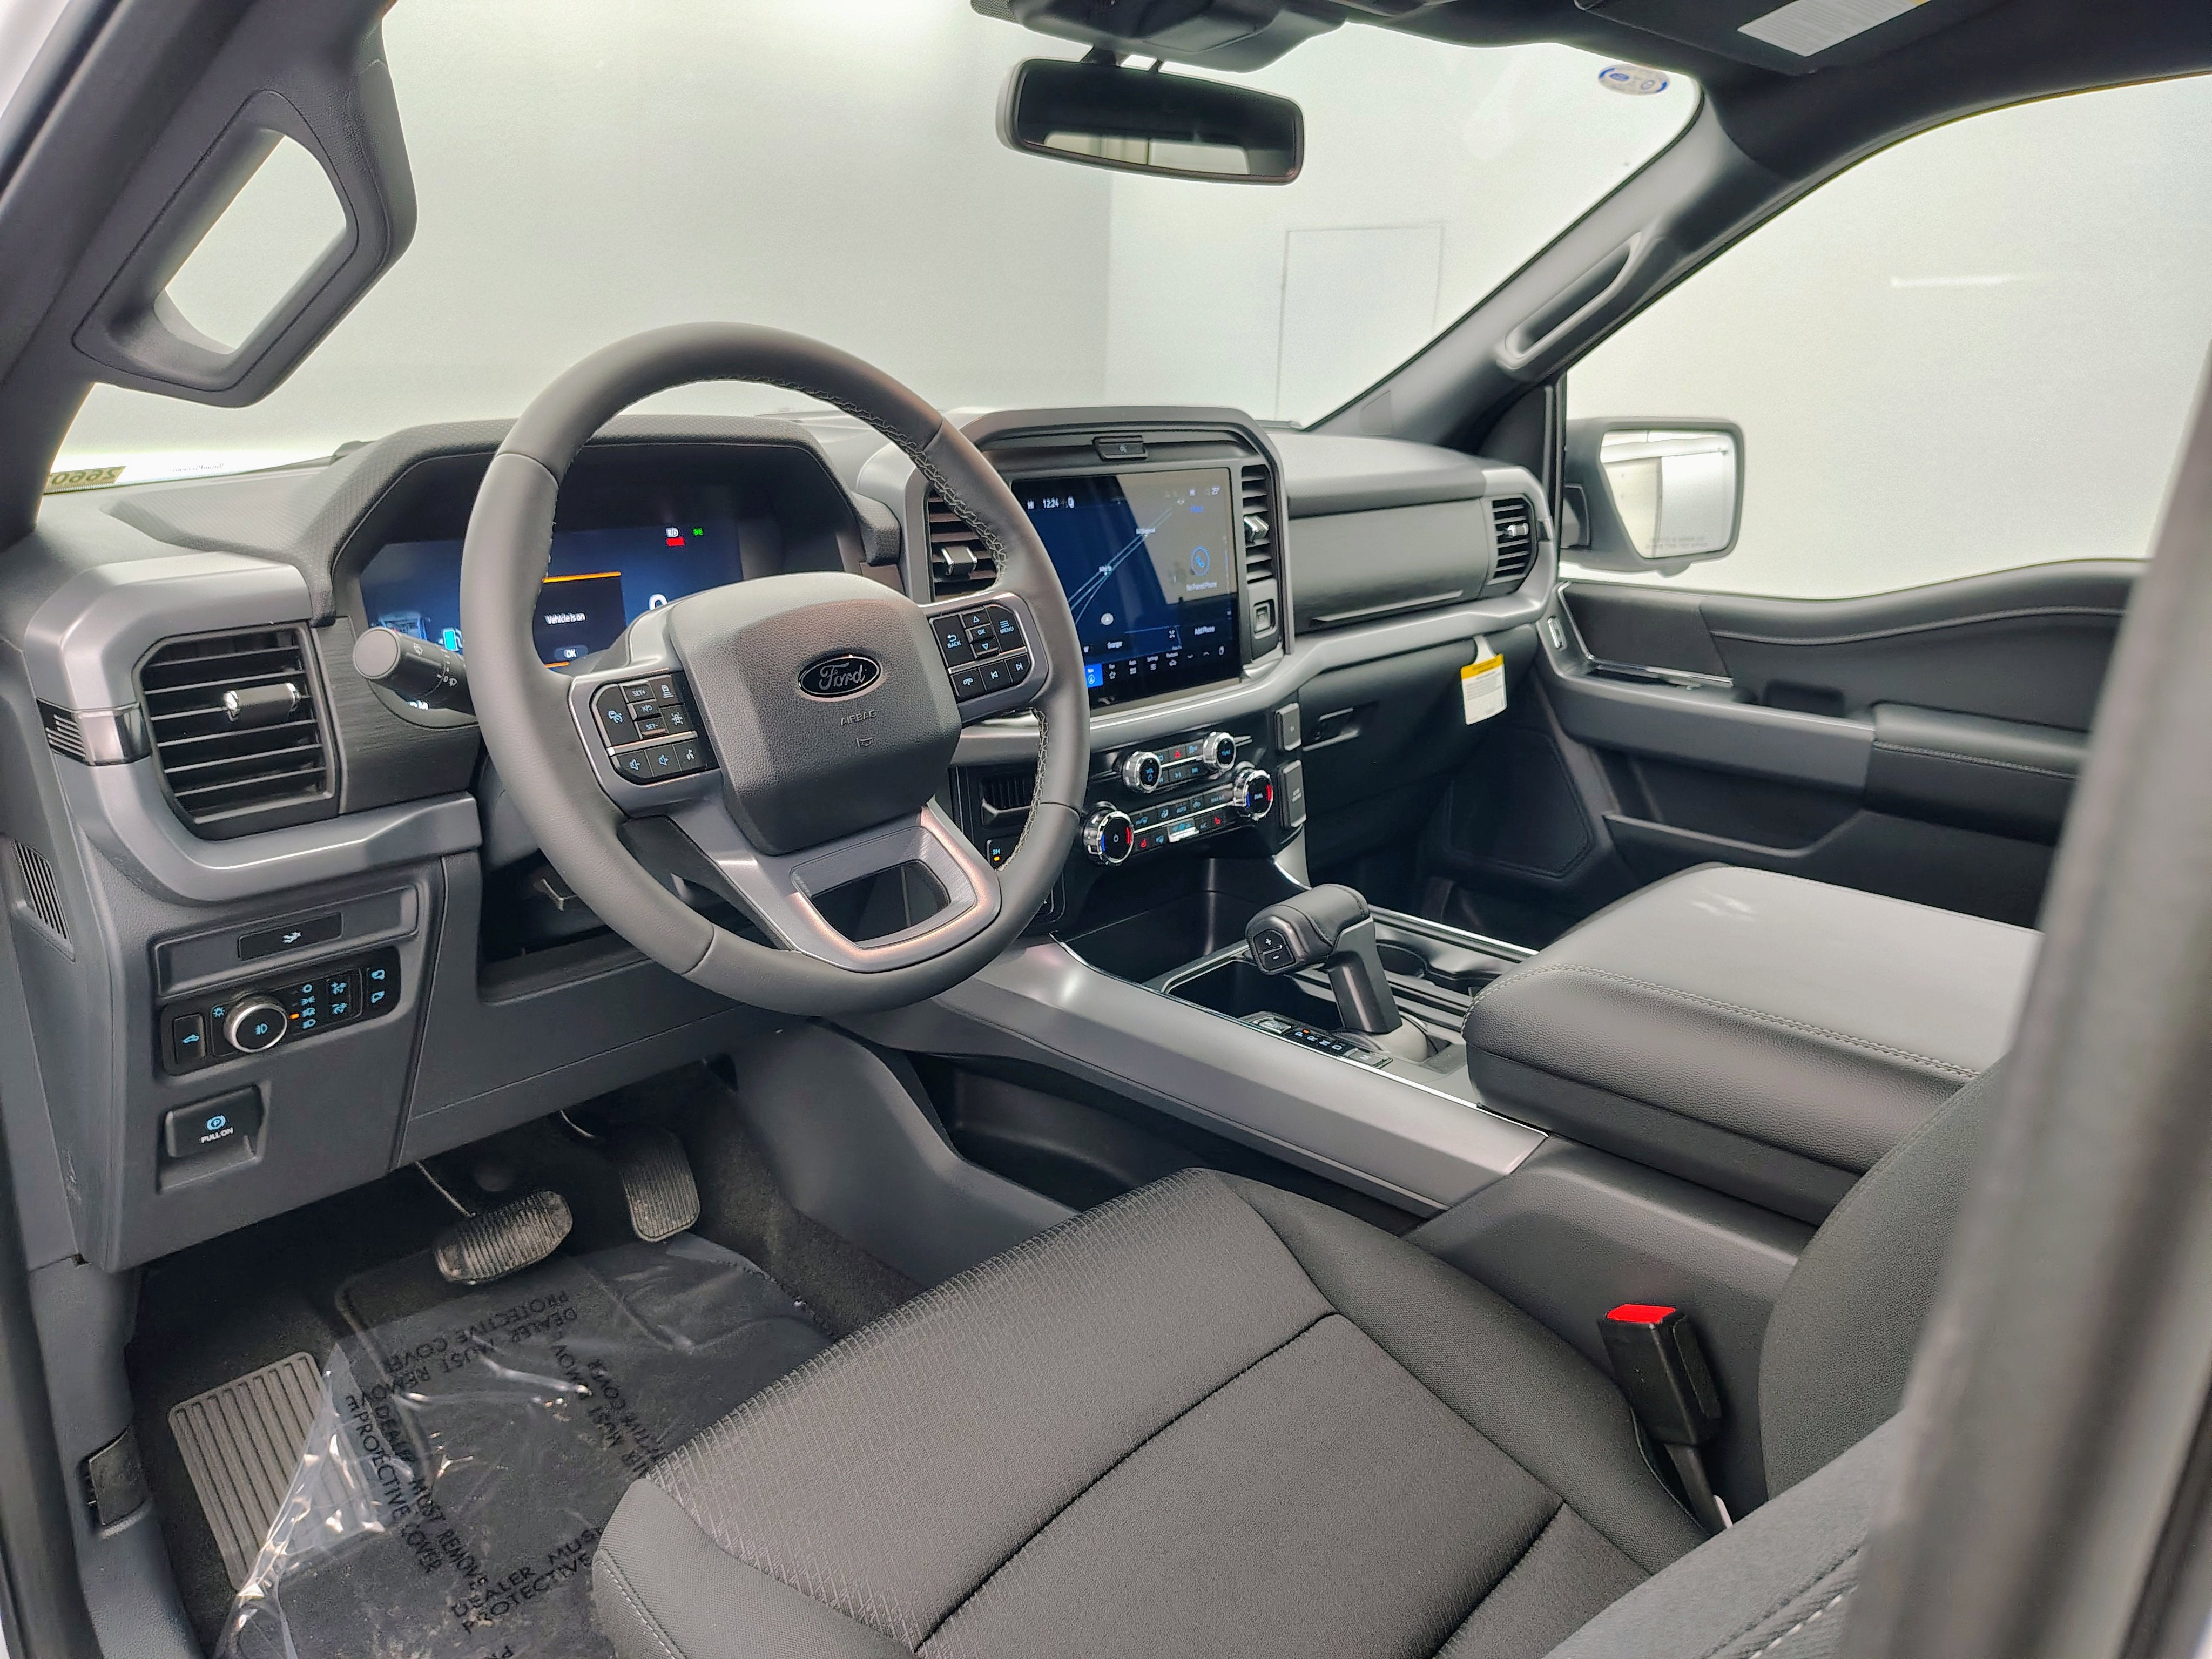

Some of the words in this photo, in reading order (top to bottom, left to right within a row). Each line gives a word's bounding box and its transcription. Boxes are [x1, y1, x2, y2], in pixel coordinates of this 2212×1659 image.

[544, 613, 570, 625] Vehicle
[576, 613, 585, 622] on
[1000, 626, 1014, 634] MENU
[564, 649, 577, 658] OK
[947, 640, 961, 649] BACK
[819, 660, 865, 691] Ford
[201, 1132, 221, 1143] PULL
[220, 1127, 233, 1137] ON
[457, 1291, 570, 1344] PROTECTIVE
[511, 1307, 578, 1344] DEALER
[381, 1337, 448, 1374] COVER
[353, 1410, 410, 1516] PROTECTIVE
[451, 1566, 536, 1617] DEALER
[461, 1553, 592, 1635] PROTECTIVE
